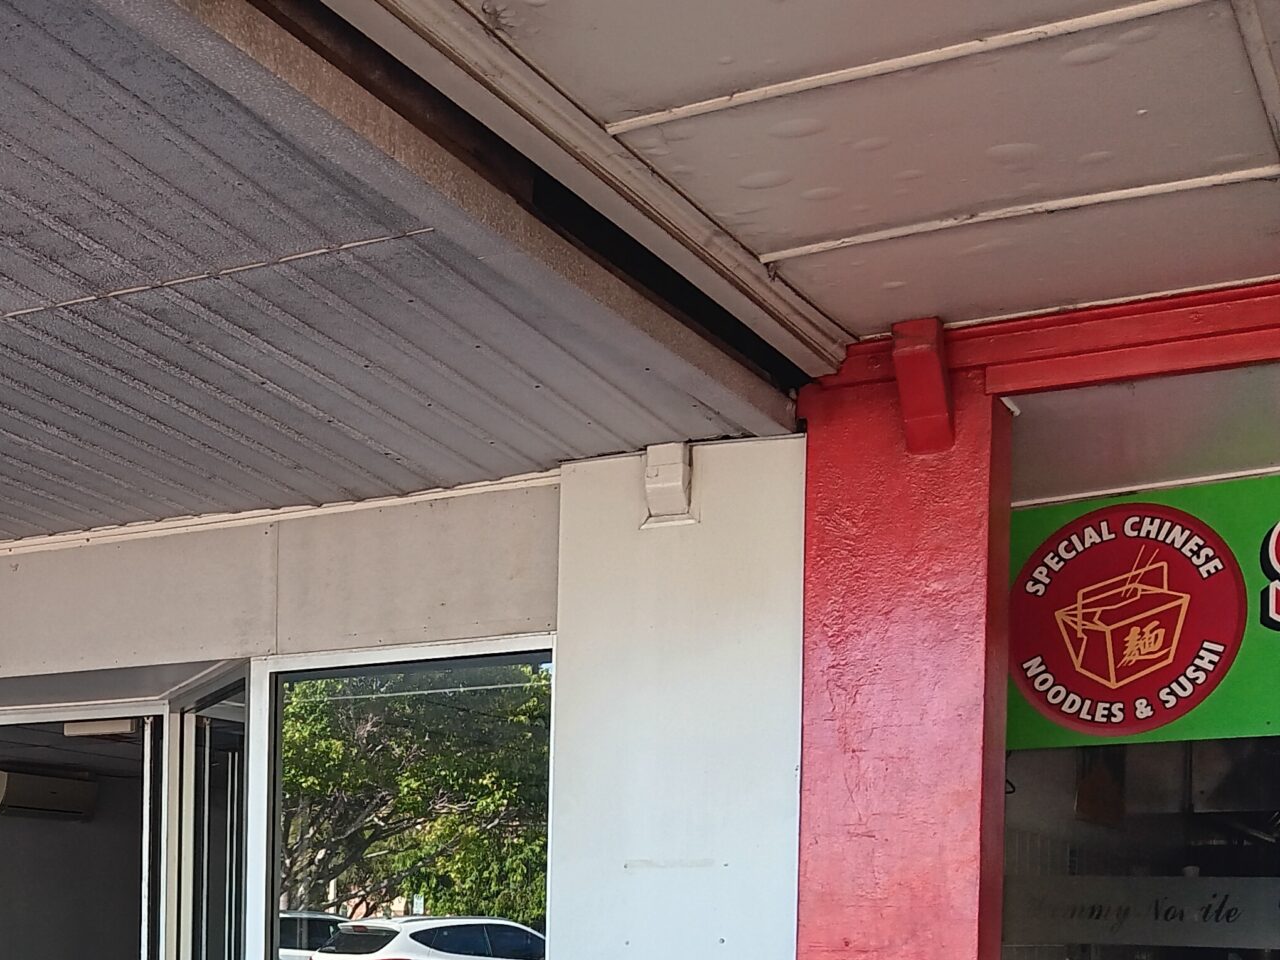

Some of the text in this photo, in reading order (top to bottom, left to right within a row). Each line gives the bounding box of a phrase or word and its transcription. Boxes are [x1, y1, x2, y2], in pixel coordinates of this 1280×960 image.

[1025, 520, 1116, 597] SPECIAL
[1123, 515, 1224, 580] CHINESE
[1022, 640, 1226, 724] NOODLES & SUSHI
